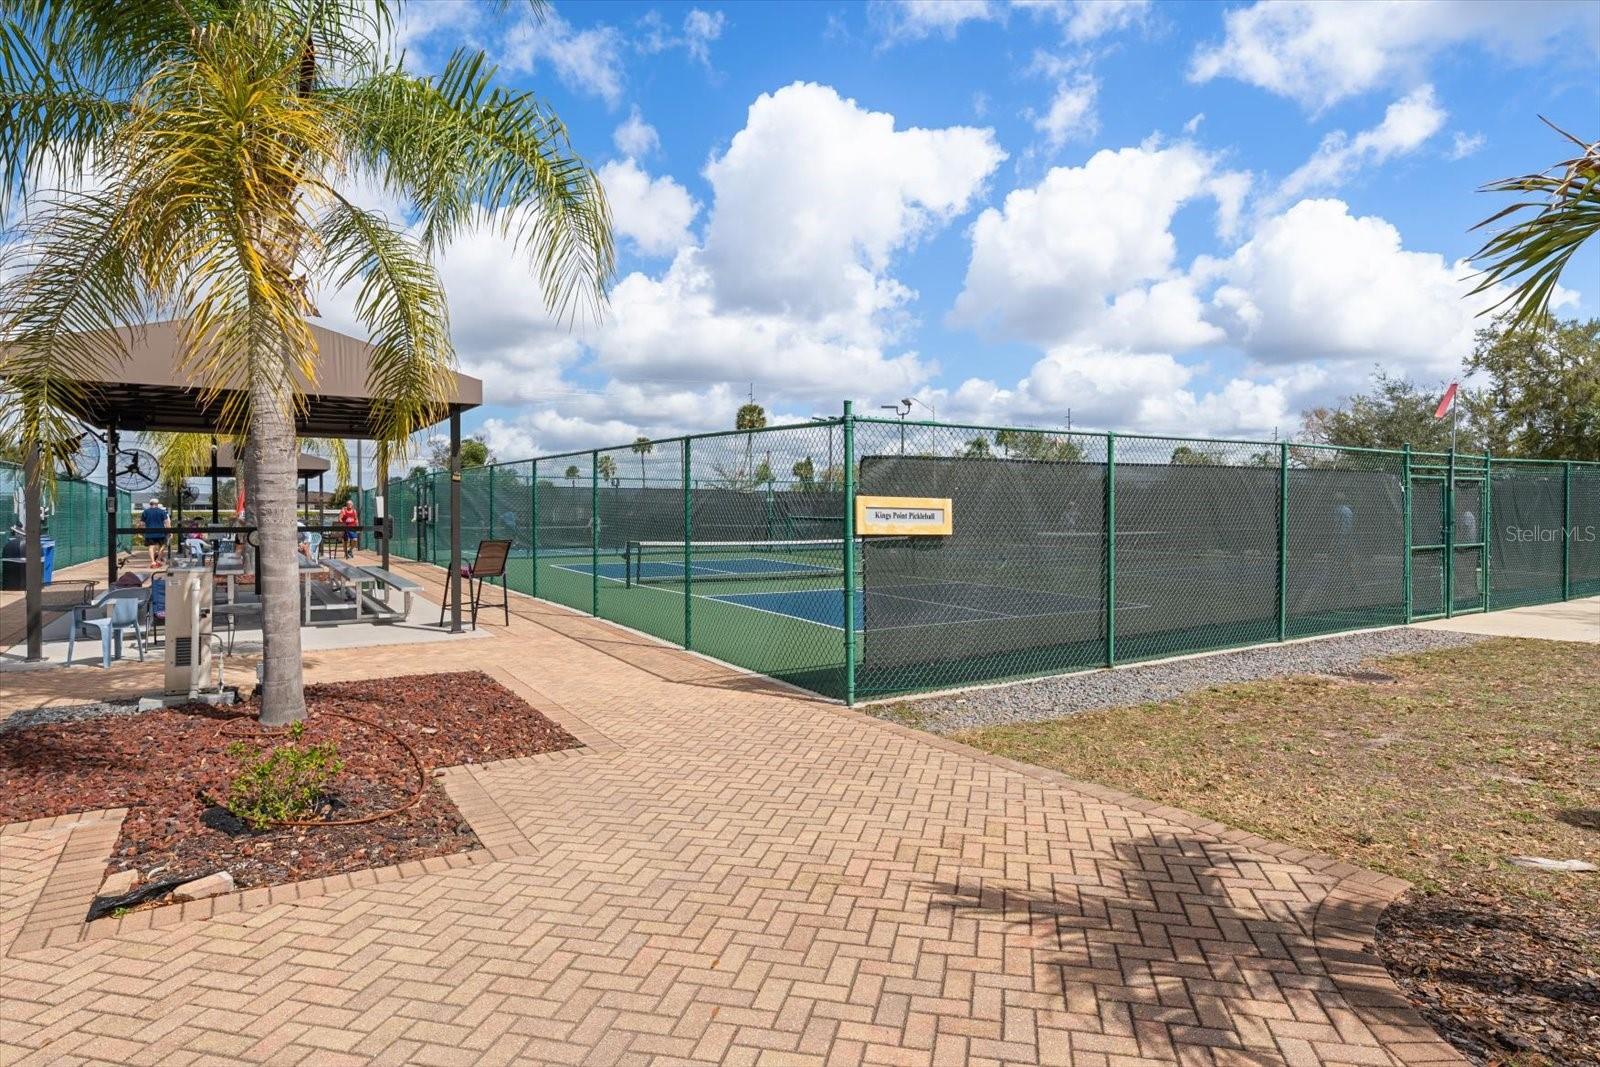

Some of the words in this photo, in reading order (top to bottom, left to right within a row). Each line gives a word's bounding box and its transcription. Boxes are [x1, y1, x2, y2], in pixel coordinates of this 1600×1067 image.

[875, 511, 891, 520] Kings
[893, 511, 907, 520] Point
[908, 512, 935, 520] Pickleball
